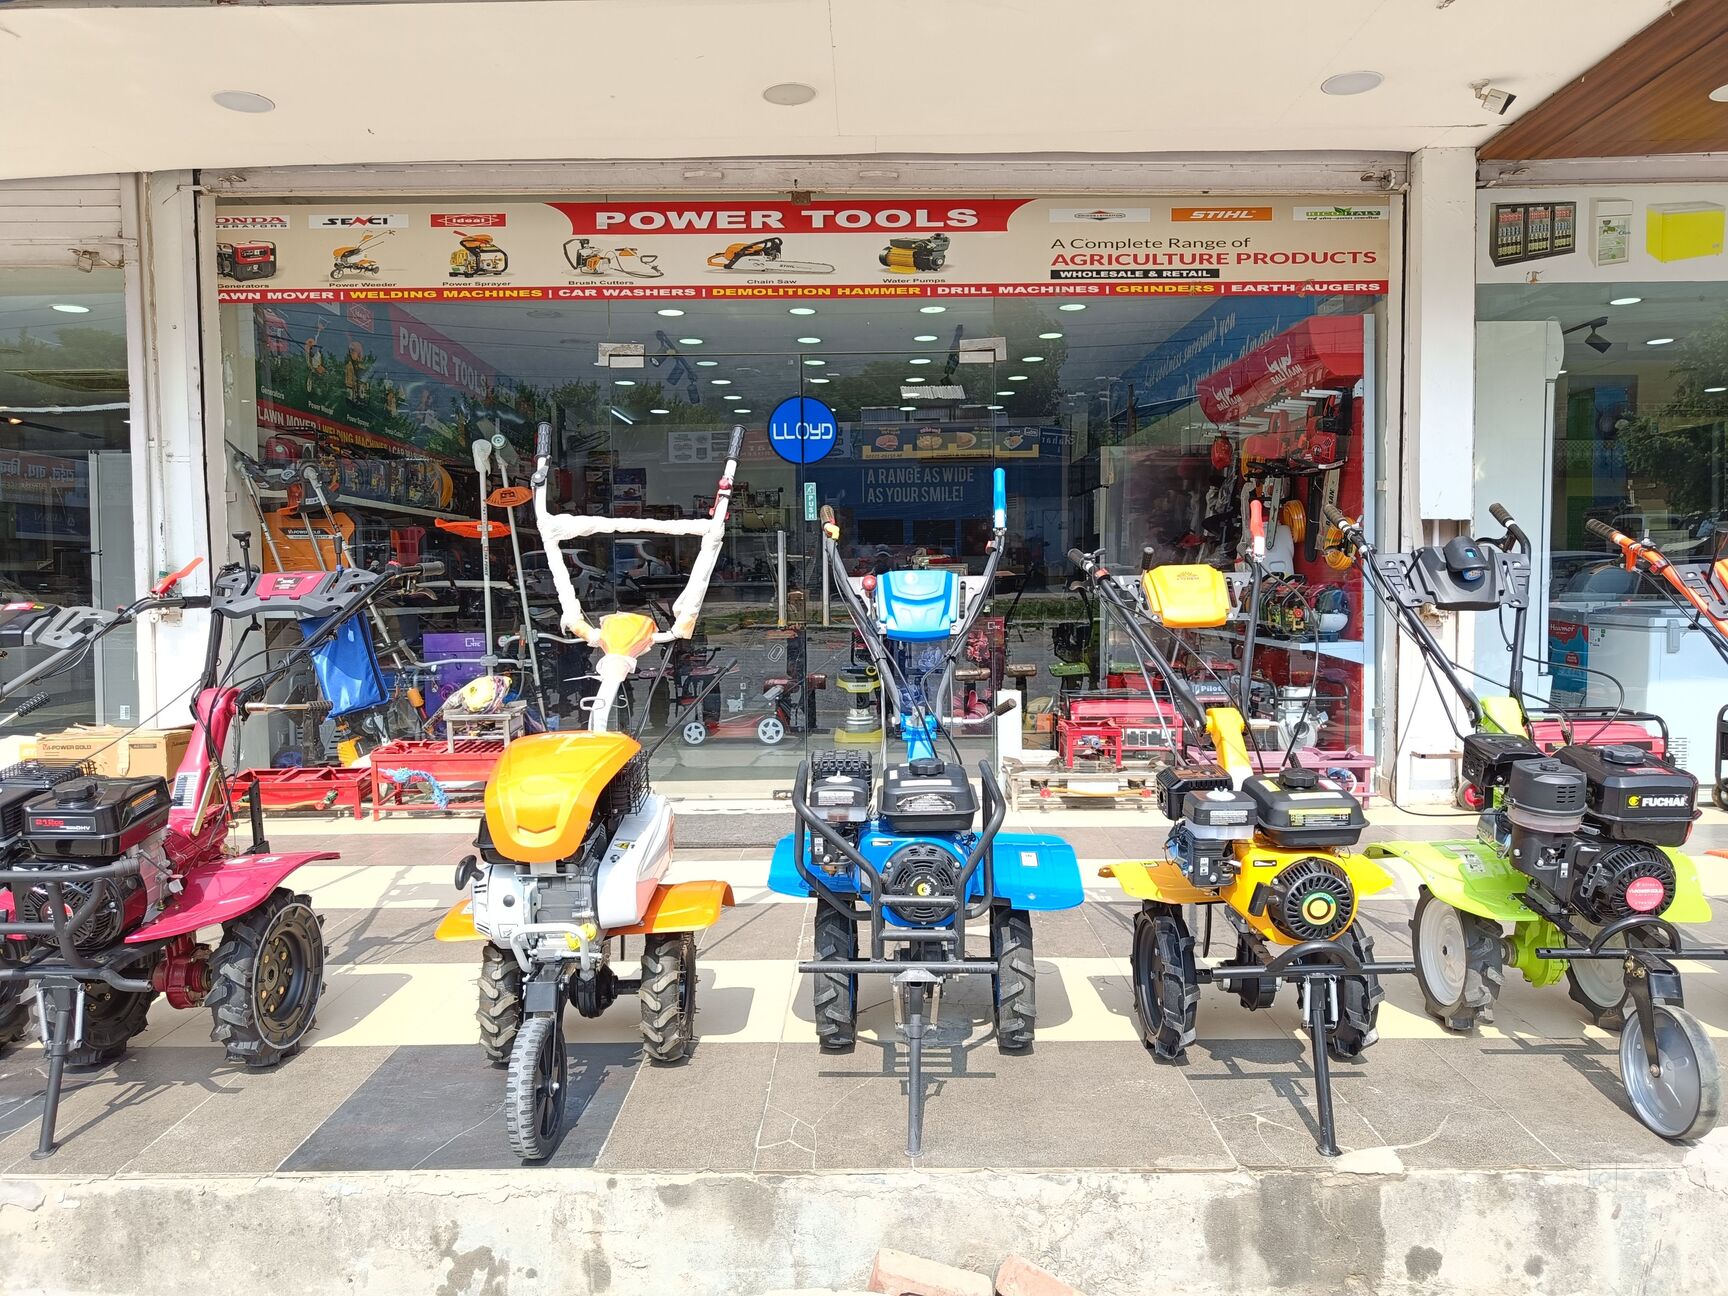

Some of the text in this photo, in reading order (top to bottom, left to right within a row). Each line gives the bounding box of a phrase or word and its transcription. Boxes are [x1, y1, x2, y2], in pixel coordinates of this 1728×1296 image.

[322, 215, 388, 227] SENCI
[595, 208, 979, 230] POWER TOOLS
[1190, 210, 1254, 219] STIHL
[1051, 237, 1251, 252] A Complete Range of
[1051, 252, 1377, 266] AGRICULTURE PRODUCTS
[350, 291, 437, 299] WELDING
[444, 290, 543, 298] MACHINES
[559, 289, 599, 297] CAR
[604, 288, 695, 297] WASHERS
[712, 287, 833, 296] DEMOLITION
[838, 287, 921, 295] HAMMER
[937, 286, 992, 295] DRILL
[998, 285, 1099, 294] MACHINES
[1115, 284, 1214, 293] GRINDERS
[1231, 284, 1295, 293] EARTH
[1302, 284, 1380, 292] AUGERS
[400, 327, 487, 397] POWER TOOLS
[260, 385, 285, 400] Generators
[257, 405, 285, 427] LAWN
[773, 422, 833, 441] LLOYD
[868, 467, 974, 484] A RANGE AS WIDE
[868, 486, 964, 503] AS YOUR SMILE!
